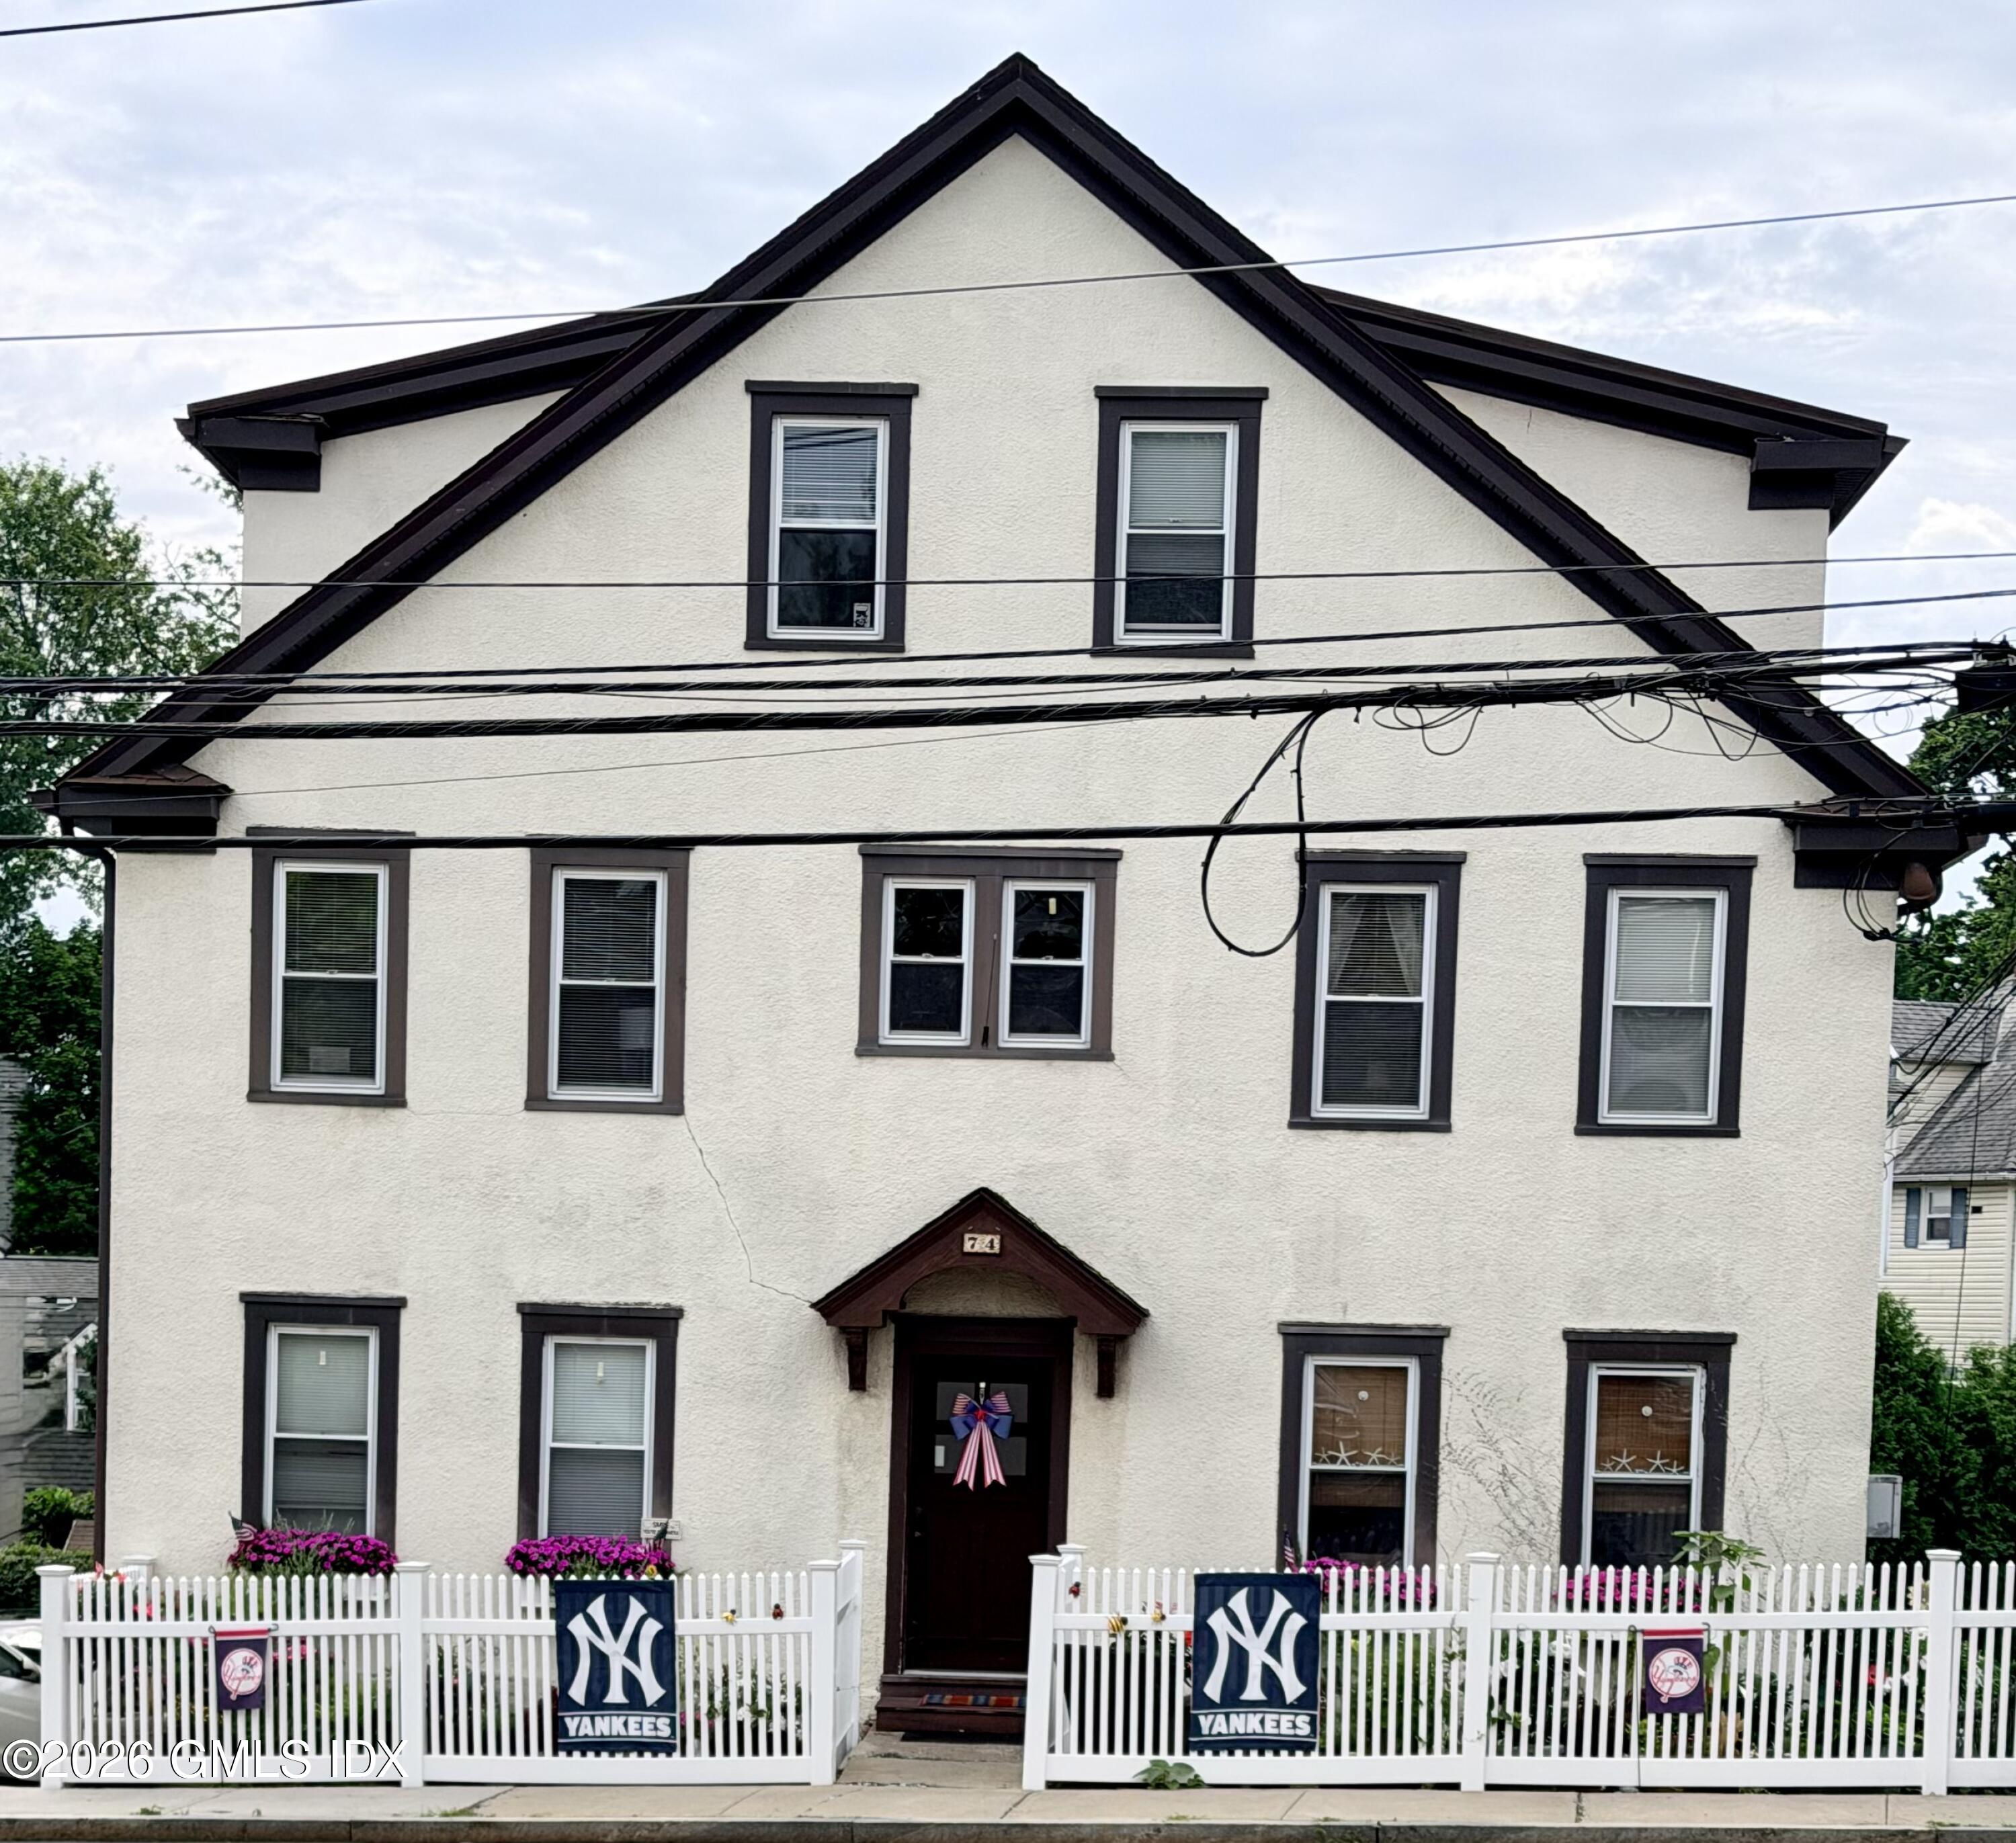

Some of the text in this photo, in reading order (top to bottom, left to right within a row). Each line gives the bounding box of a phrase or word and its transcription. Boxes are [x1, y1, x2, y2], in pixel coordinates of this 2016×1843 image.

[968, 1237, 996, 1250] 74
[566, 1593, 667, 1707] NY
[1202, 1586, 1308, 1705] NY
[564, 1716, 671, 1738] YANKEES
[1198, 1713, 1311, 1735] YANKEES
